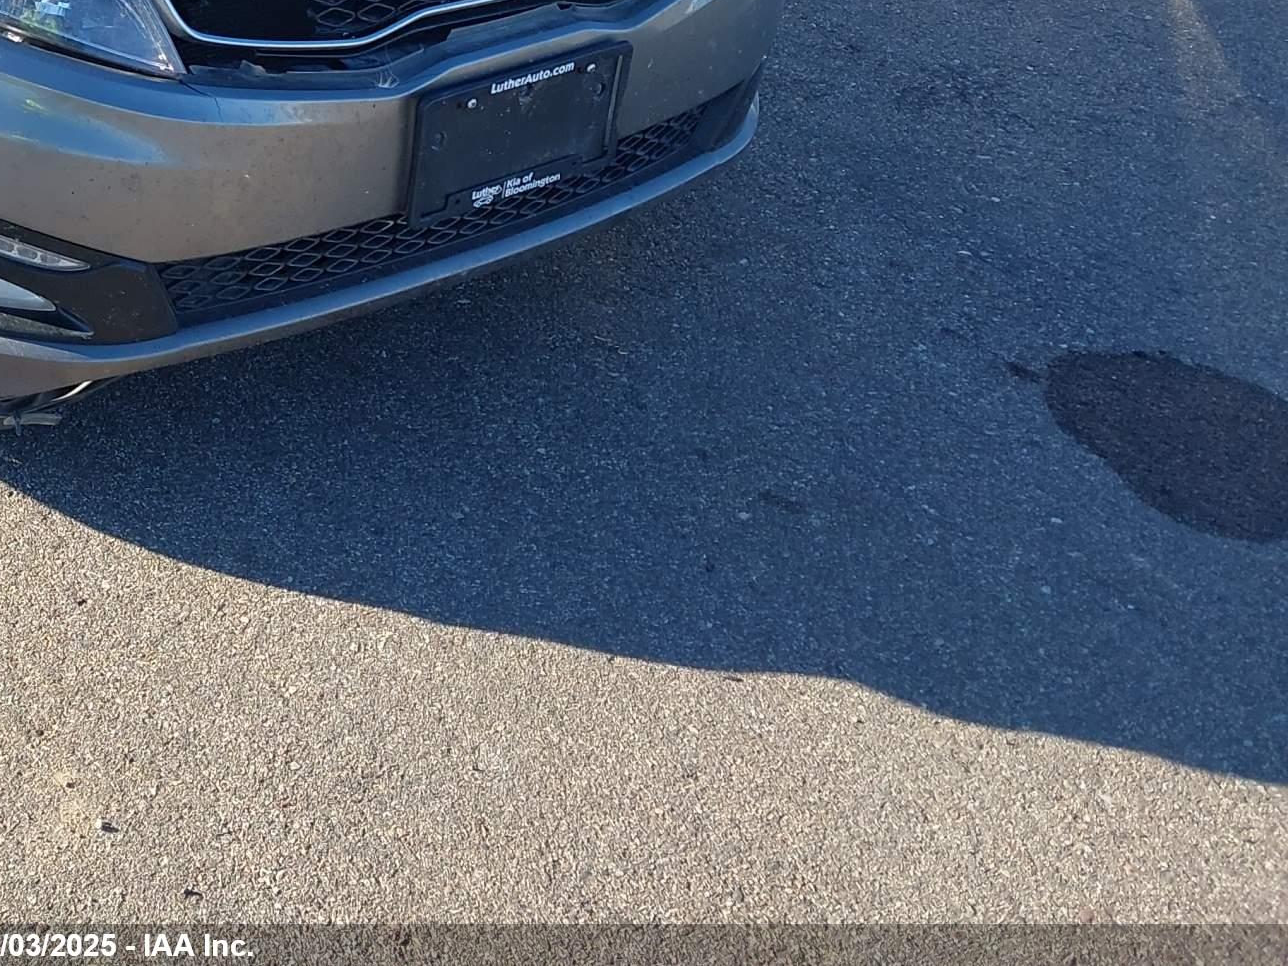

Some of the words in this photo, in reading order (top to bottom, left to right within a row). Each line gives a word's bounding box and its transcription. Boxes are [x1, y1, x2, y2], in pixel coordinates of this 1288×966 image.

[490, 62, 575, 94] LutherAuto.com
[505, 173, 561, 197] Bloomington
[506, 178, 521, 189] Kia
[522, 172, 534, 183] of
